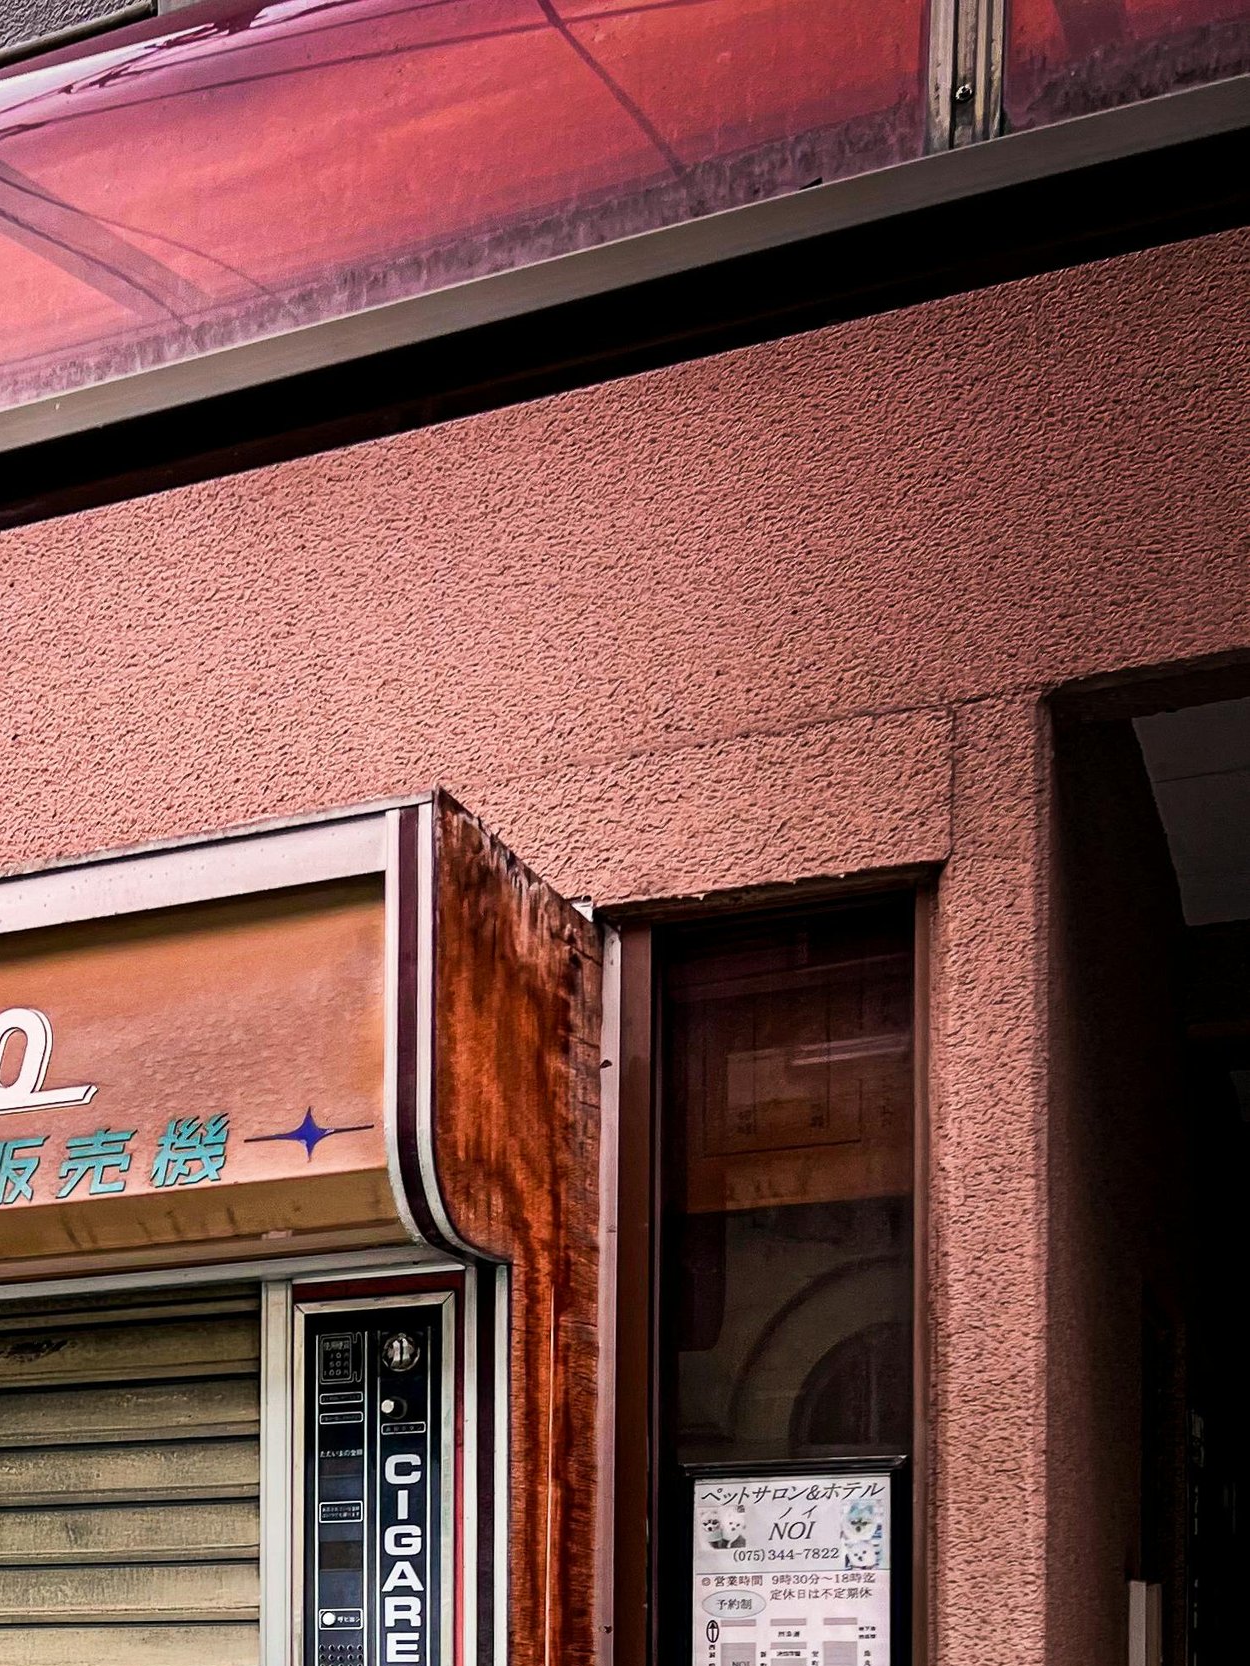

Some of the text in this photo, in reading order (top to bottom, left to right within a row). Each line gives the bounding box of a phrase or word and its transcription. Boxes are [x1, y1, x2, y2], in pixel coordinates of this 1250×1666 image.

[701, 1482, 885, 1505] ペットサロン&ホテル
[768, 1521, 816, 1541] NOI
[716, 1599, 753, 1611] 予約制
